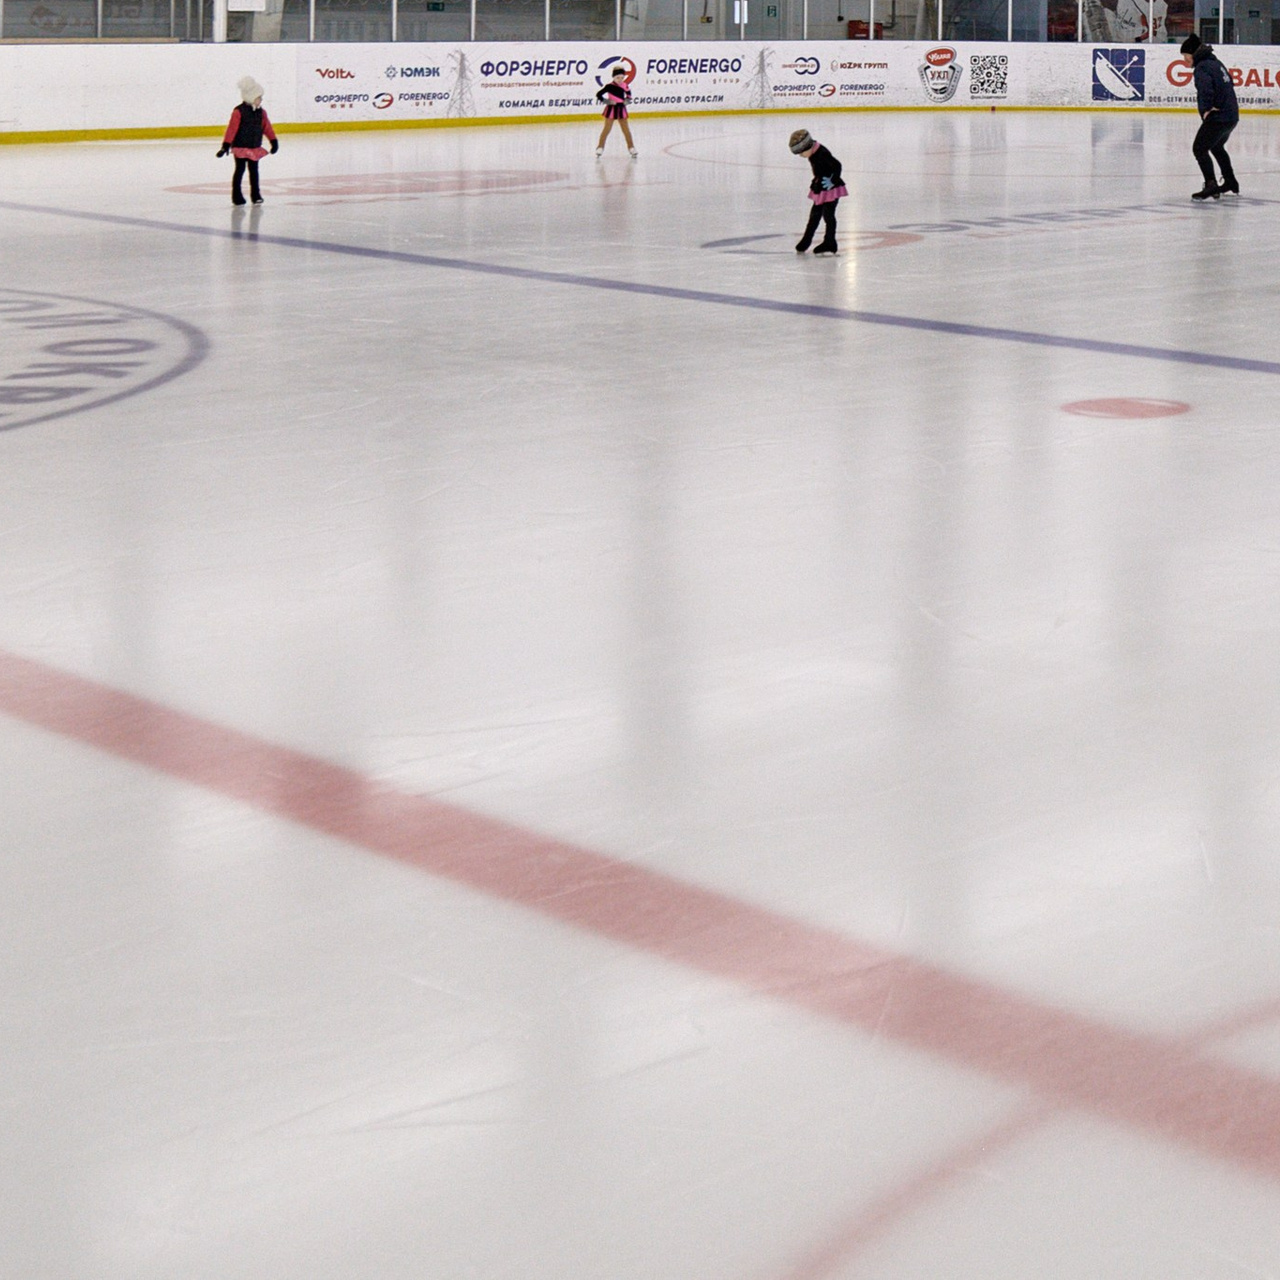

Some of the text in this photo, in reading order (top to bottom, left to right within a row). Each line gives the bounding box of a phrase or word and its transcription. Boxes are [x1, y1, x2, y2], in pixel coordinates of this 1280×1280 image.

[480, 60, 588, 77] ФОРЭНЕРГО
[646, 58, 742, 74] FORENERGO
[315, 68, 356, 79] Volta
[400, 66, 441, 78] ЮМЭК
[929, 70, 949, 80] УХЛ
[1166, 59, 1275, 88] GBAL
[772, 84, 816, 92] ФОРЭНЕРГО
[839, 83, 885, 91] FORENERGO
[314, 93, 370, 103] ФОРЭНЕРГО
[398, 92, 450, 101] FORENERGO
[498, 99, 545, 108] КОМАНДА
[548, 98, 593, 108] ВЕДУЩИХ
[684, 95, 724, 104] ОТРАСЛИ
